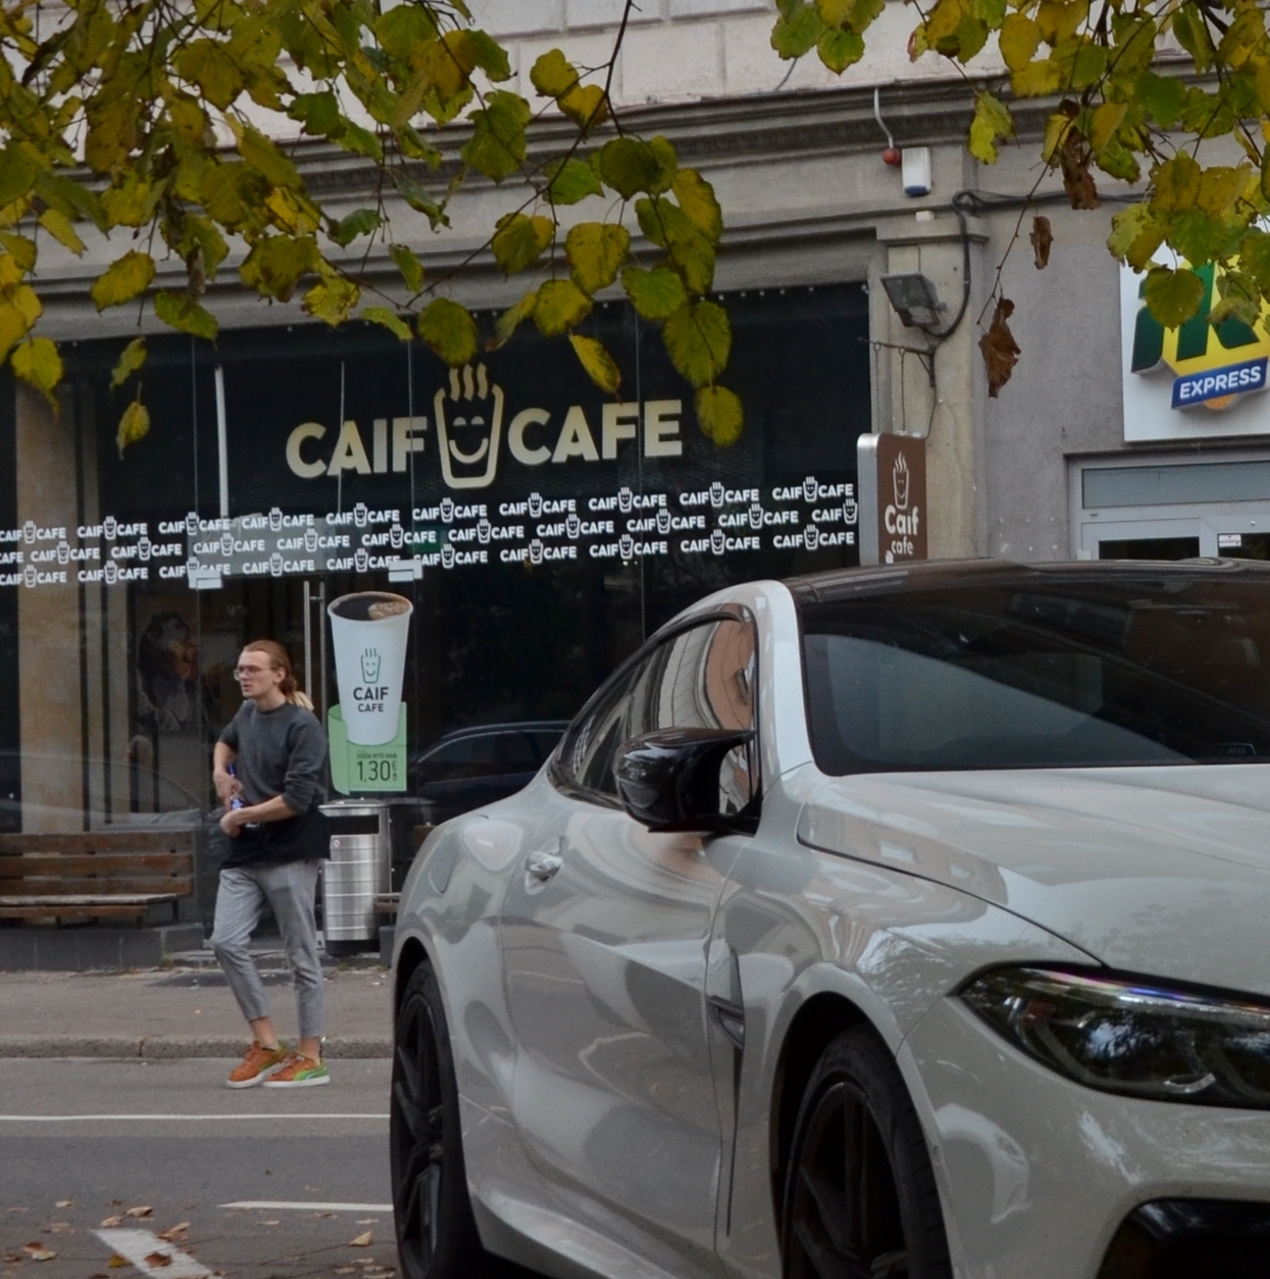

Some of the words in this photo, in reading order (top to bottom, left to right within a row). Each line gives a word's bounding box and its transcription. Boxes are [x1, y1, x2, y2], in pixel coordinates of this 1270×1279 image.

[1178, 365, 1262, 400] EXPRESS
[286, 416, 428, 478] CAIF
[508, 399, 682, 466] CAFE
[0, 530, 22, 542] CAIF
[37, 528, 66, 540] CAFE
[77, 525, 103, 538] CAIF
[117, 523, 147, 536] CAFE
[159, 521, 185, 534] CAIF
[199, 519, 230, 531] CAFE
[242, 517, 268, 529] CAIF
[283, 514, 314, 527] CAFE
[326, 513, 353, 525] CAIF
[367, 510, 399, 522] CAFE
[412, 508, 439, 520] CAIF
[454, 505, 487, 518] CAFE
[499, 503, 527, 515] CAIF
[543, 500, 576, 513] CAFE
[588, 497, 617, 510] CAIF
[633, 494, 667, 508] CAFE
[679, 492, 709, 505] CAIF
[725, 489, 759, 502] CAFE
[772, 486, 802, 500] CAIF
[818, 484, 853, 497] CAFE
[884, 504, 919, 535] Caif
[0, 552, 23, 564] AFE
[30, 550, 56, 562] CAIF
[70, 548, 100, 560] CAFE
[111, 546, 137, 558] CAIF
[151, 544, 182, 556] CAFE
[193, 542, 219, 554] CAIF
[234, 540, 265, 552] CAFE
[277, 538, 303, 550] CAIF
[318, 535, 350, 547] CAFE
[362, 533, 389, 546] CAIF
[404, 531, 436, 543] CAFE
[448, 528, 476, 541] CAIF
[491, 526, 524, 539] CAFE
[537, 524, 565, 537] CAIF
[580, 521, 614, 534] CAFE
[626, 519, 655, 532] CAIF
[671, 516, 705, 529] CAFE
[718, 514, 748, 527] CAIF
[764, 511, 799, 524] CAFE
[812, 508, 842, 522] CAIF
[891, 535, 914, 555] cafe
[0, 574, 23, 586] CAIF
[37, 572, 67, 584] CAFE
[78, 570, 104, 582] CAIF
[118, 567, 148, 580] CAFE
[159, 566, 185, 578] CAIF
[242, 562, 269, 574] CAIF
[284, 560, 315, 572] CAFE
[327, 558, 354, 570] CAIF
[455, 551, 488, 564] CAFE
[500, 549, 528, 561] CAIF
[544, 546, 577, 559] CAFE
[589, 544, 618, 557] CAIF
[634, 542, 667, 555] CAFE
[680, 539, 710, 552] CAIF
[725, 537, 760, 550] CAFE
[773, 534, 803, 548] CAIF
[819, 532, 854, 545] CAFE
[353, 687, 389, 701] CAIF
[358, 703, 384, 713] CAFE
[357, 760, 391, 783] 1,30
